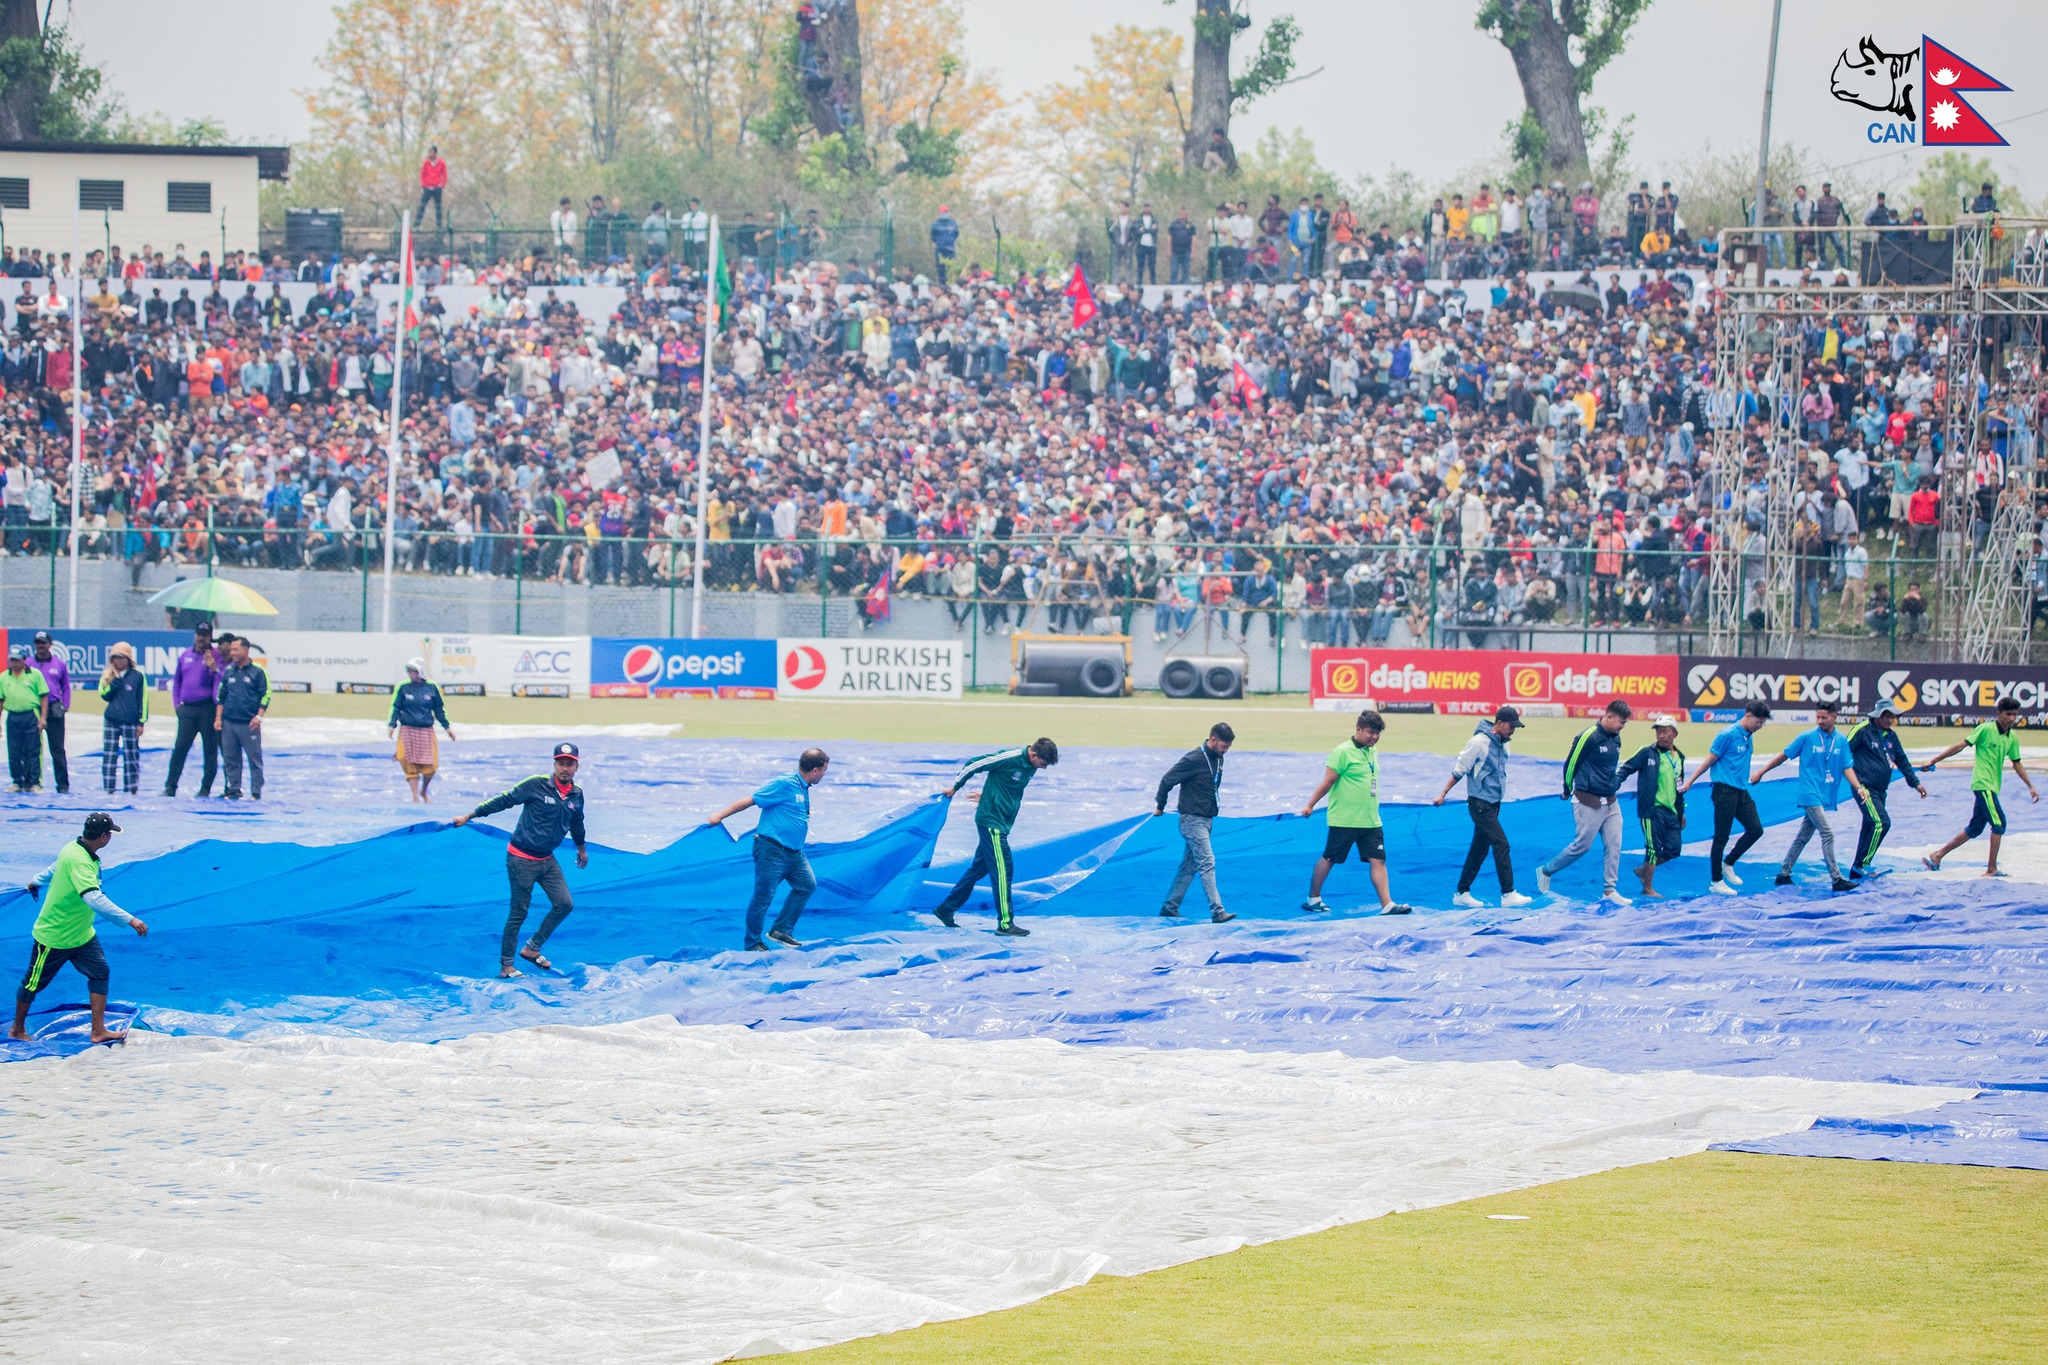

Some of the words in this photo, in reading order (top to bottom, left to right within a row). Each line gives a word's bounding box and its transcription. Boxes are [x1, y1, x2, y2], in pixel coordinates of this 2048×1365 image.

[276, 657, 299, 665] THE
[324, 657, 369, 666] GROUP
[513, 650, 571, 673] ACC
[667, 651, 745, 681] pepsi
[840, 647, 951, 667] TURKISH
[840, 672, 952, 692] AIRLINES
[1729, 673, 1860, 703] SKYEXCH
[1461, 701, 1490, 714] KFC
[1715, 712, 1737, 722] pepsi
[1898, 716, 1937, 725] SKYEXCH
